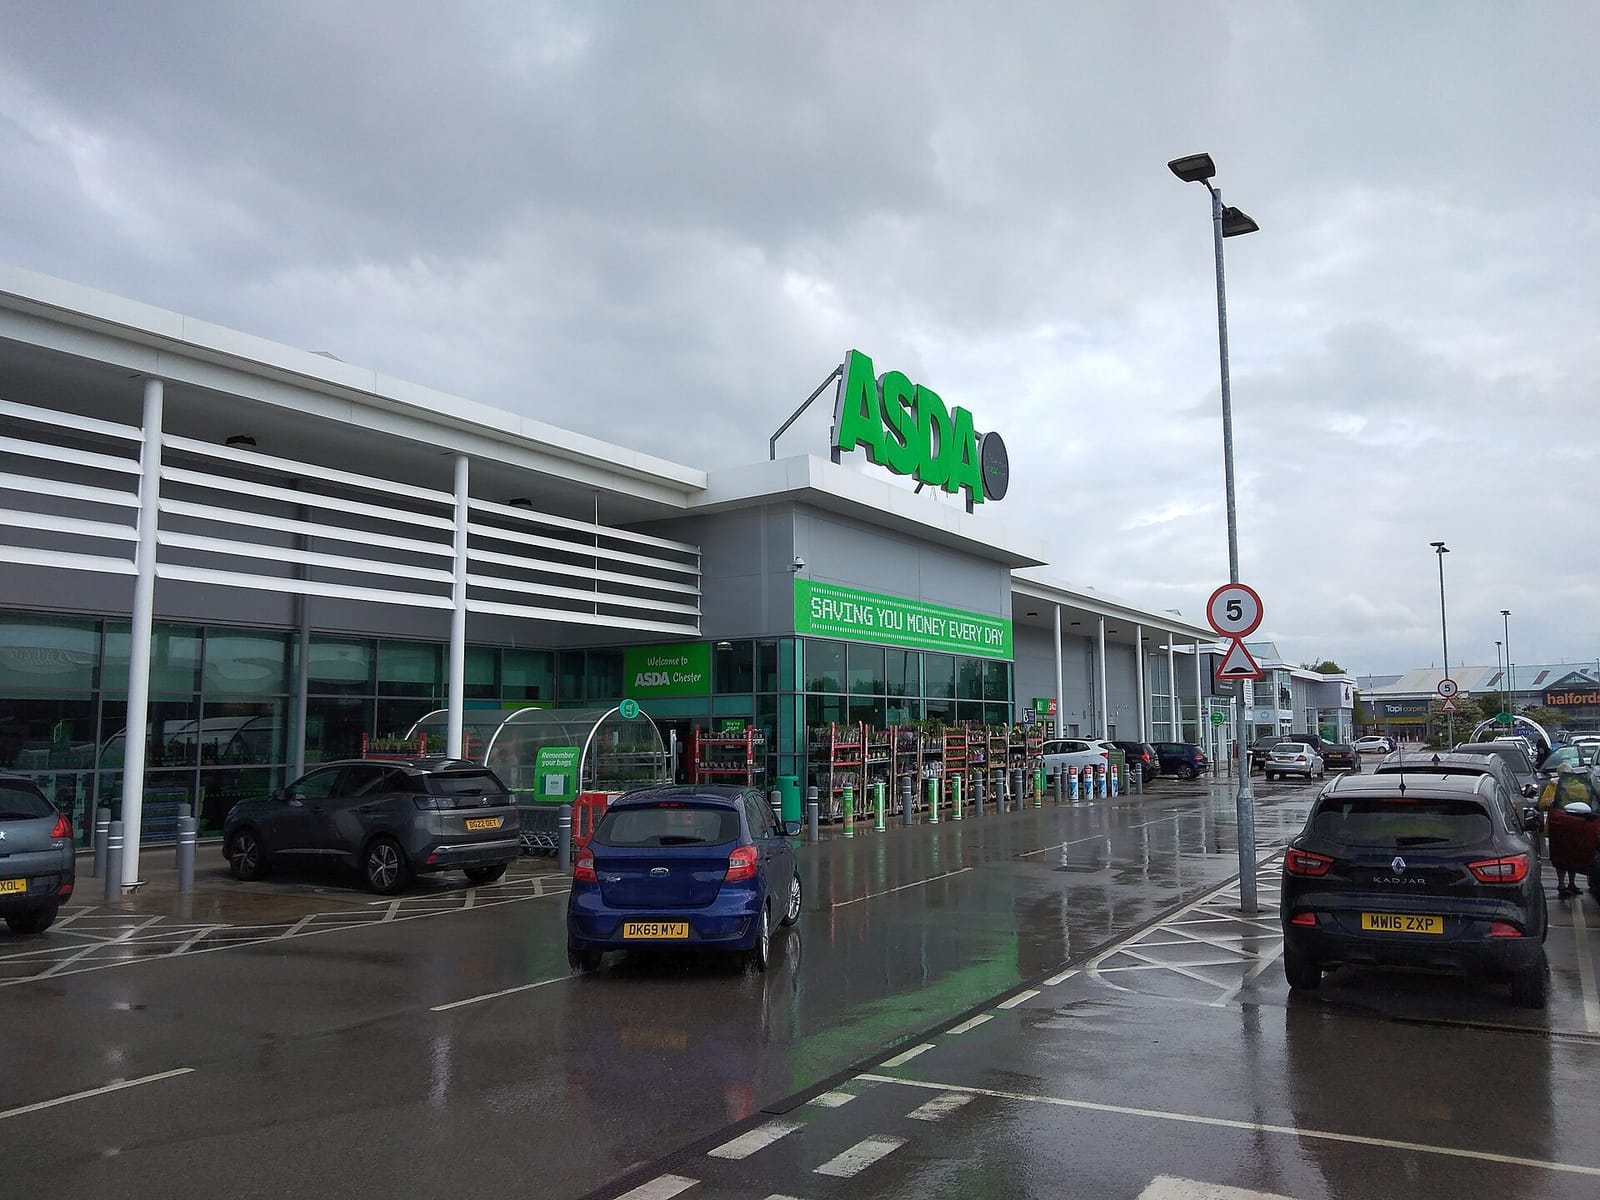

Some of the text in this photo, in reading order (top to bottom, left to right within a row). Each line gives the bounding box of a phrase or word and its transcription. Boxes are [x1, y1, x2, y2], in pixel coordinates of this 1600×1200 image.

[833, 349, 984, 504] ASDA
[1226, 599, 1243, 622] 5
[811, 597, 1004, 646] SAVING YOU MONEY EVERY DAY
[647, 656, 689, 667] Welcome to
[634, 671, 702, 687] ASDA Chester
[1444, 684, 1451, 692] 5
[1385, 704, 1402, 714] Tapi
[556, 759, 572, 767] bags
[1373, 876, 1427, 885] KADJAR
[1370, 915, 1434, 930] MW16 ZXP
[629, 924, 684, 936] DK69 MYJ
